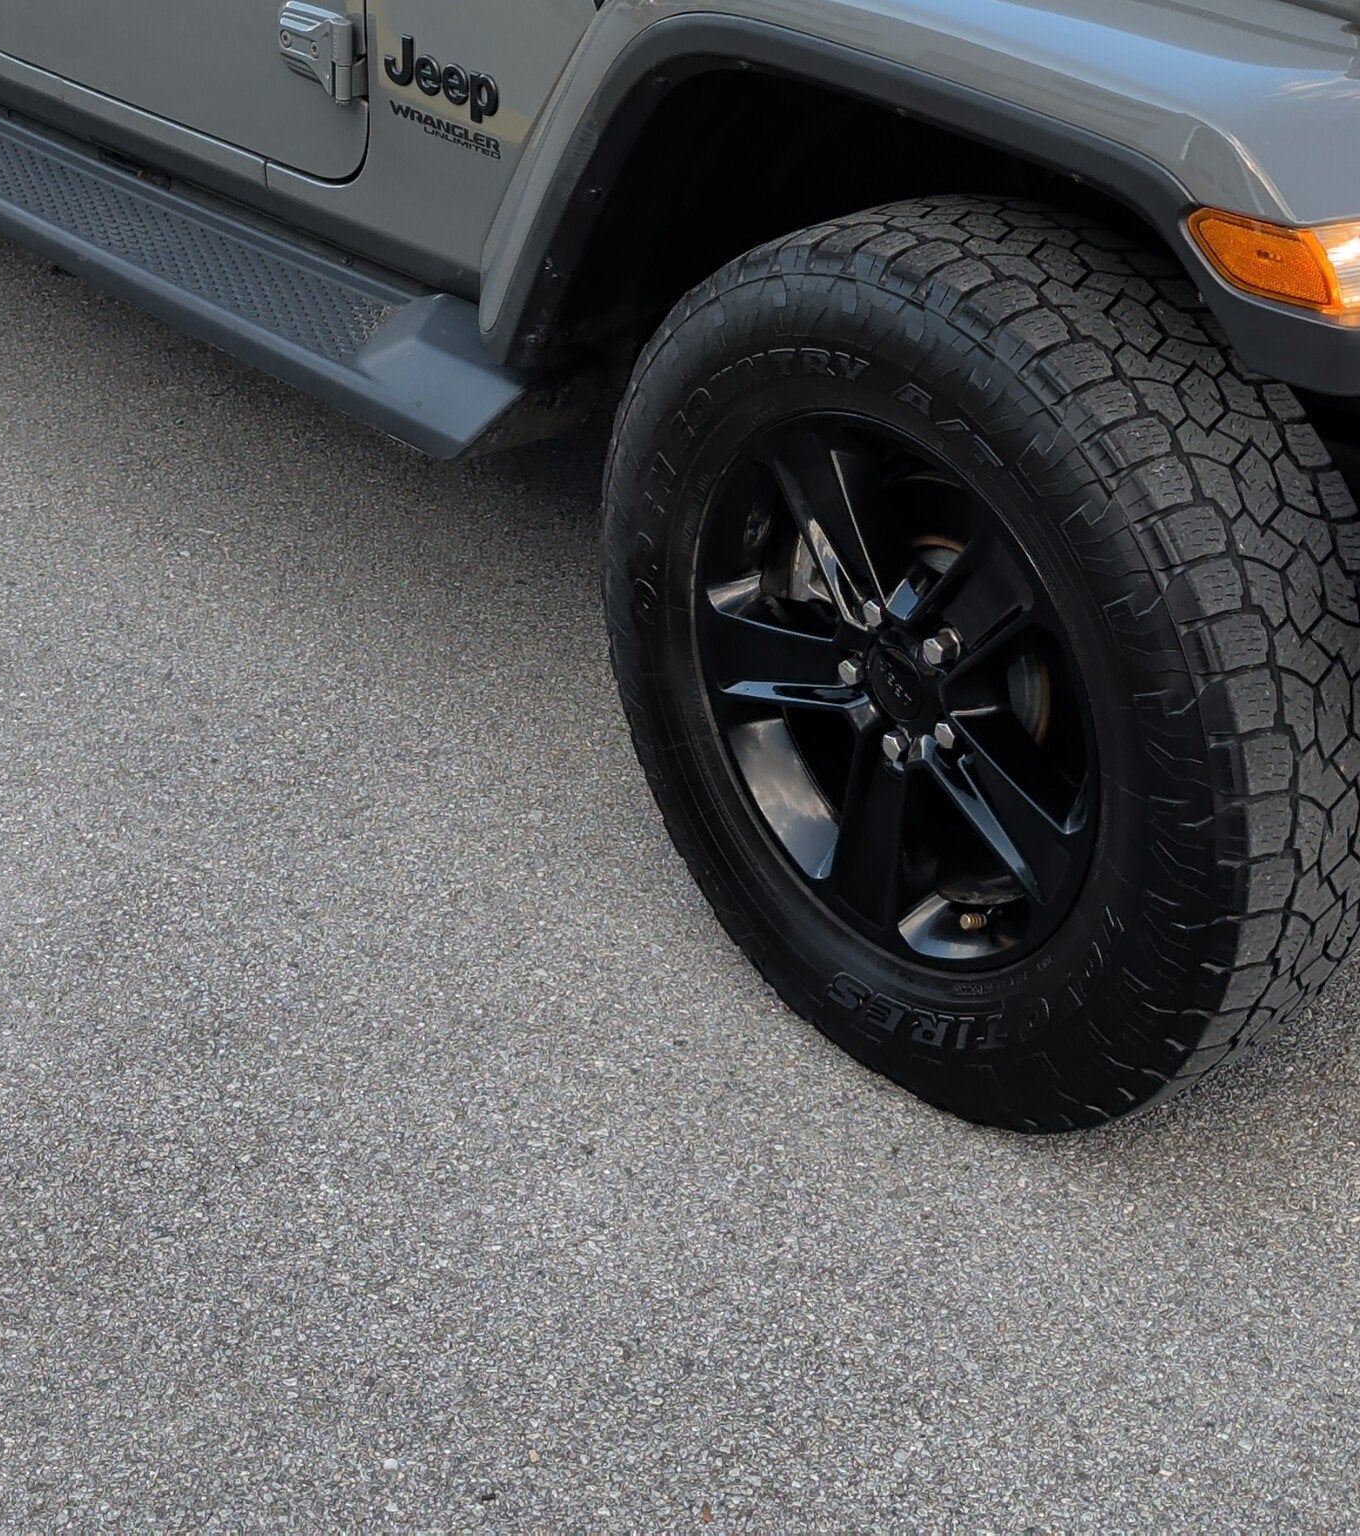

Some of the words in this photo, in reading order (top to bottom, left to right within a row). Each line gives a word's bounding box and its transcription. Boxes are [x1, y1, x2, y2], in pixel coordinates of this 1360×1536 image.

[384, 33, 499, 124] Jeep
[389, 99, 501, 153] WRANGLER
[424, 126, 502, 160] UNLIMITED
[669, 345, 871, 439] COUNTRY
[824, 970, 1010, 1052] TIRES
